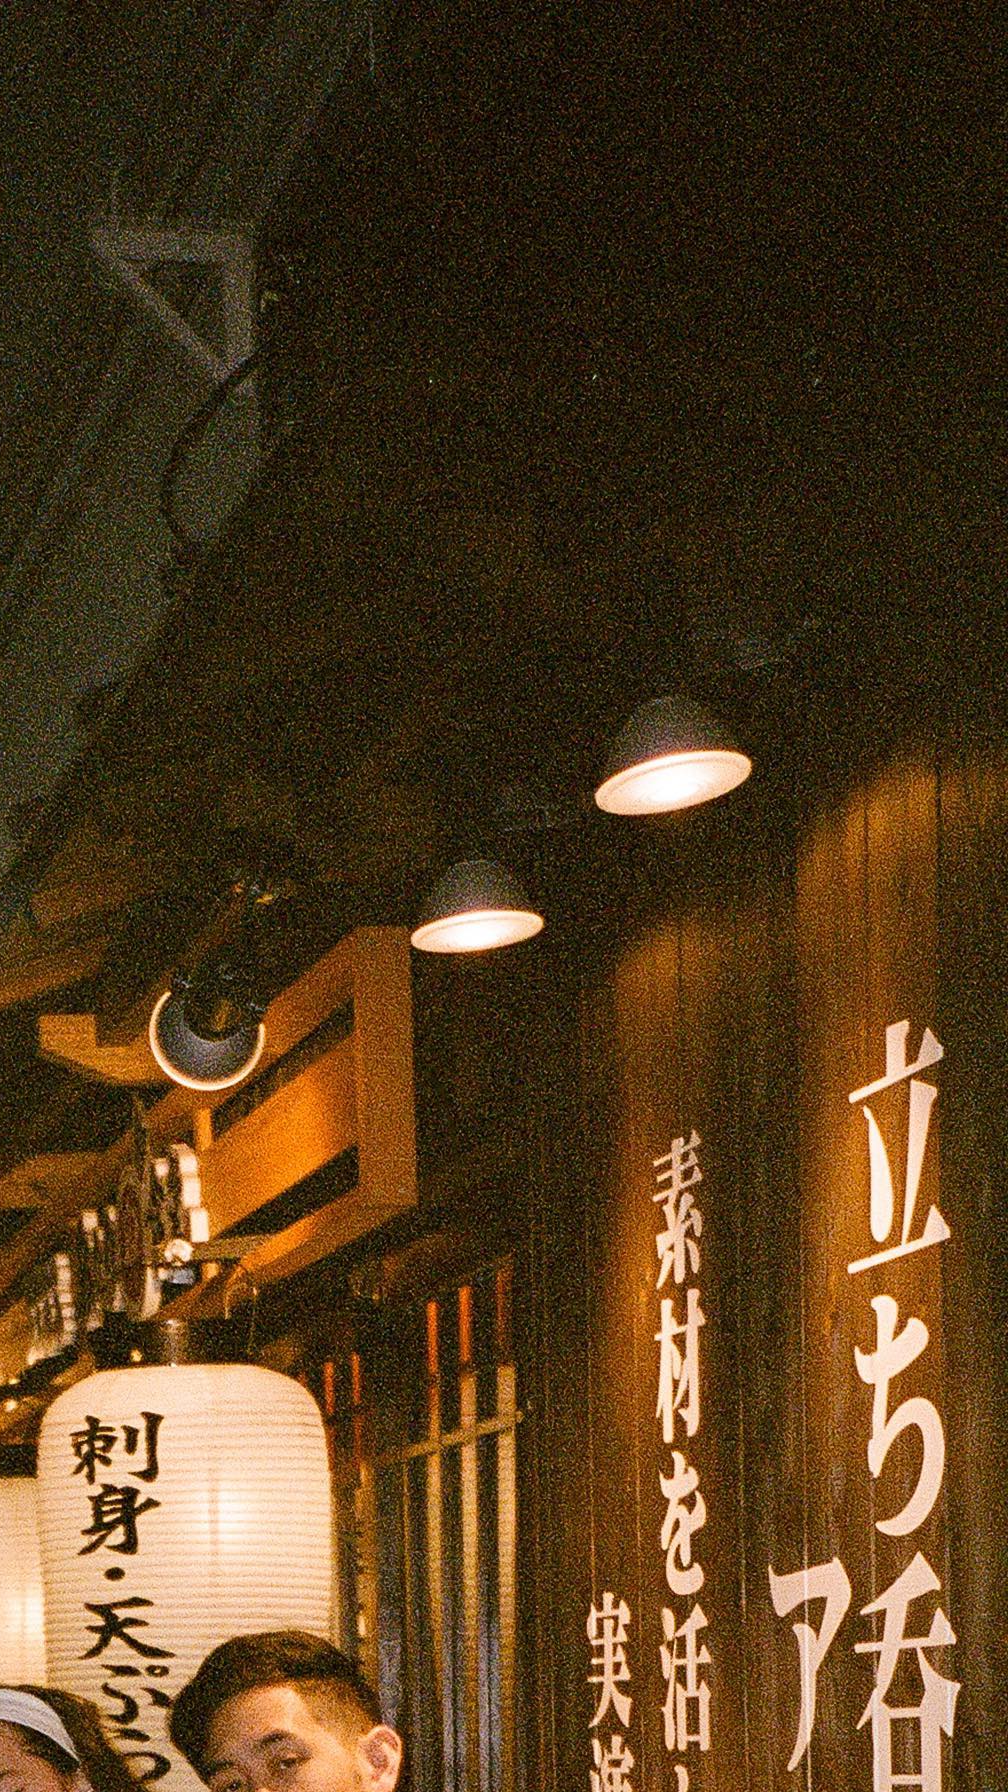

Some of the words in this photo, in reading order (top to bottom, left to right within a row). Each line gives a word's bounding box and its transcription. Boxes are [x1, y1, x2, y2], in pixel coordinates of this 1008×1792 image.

[69, 1411, 177, 1782] 刺身・天ぷら
